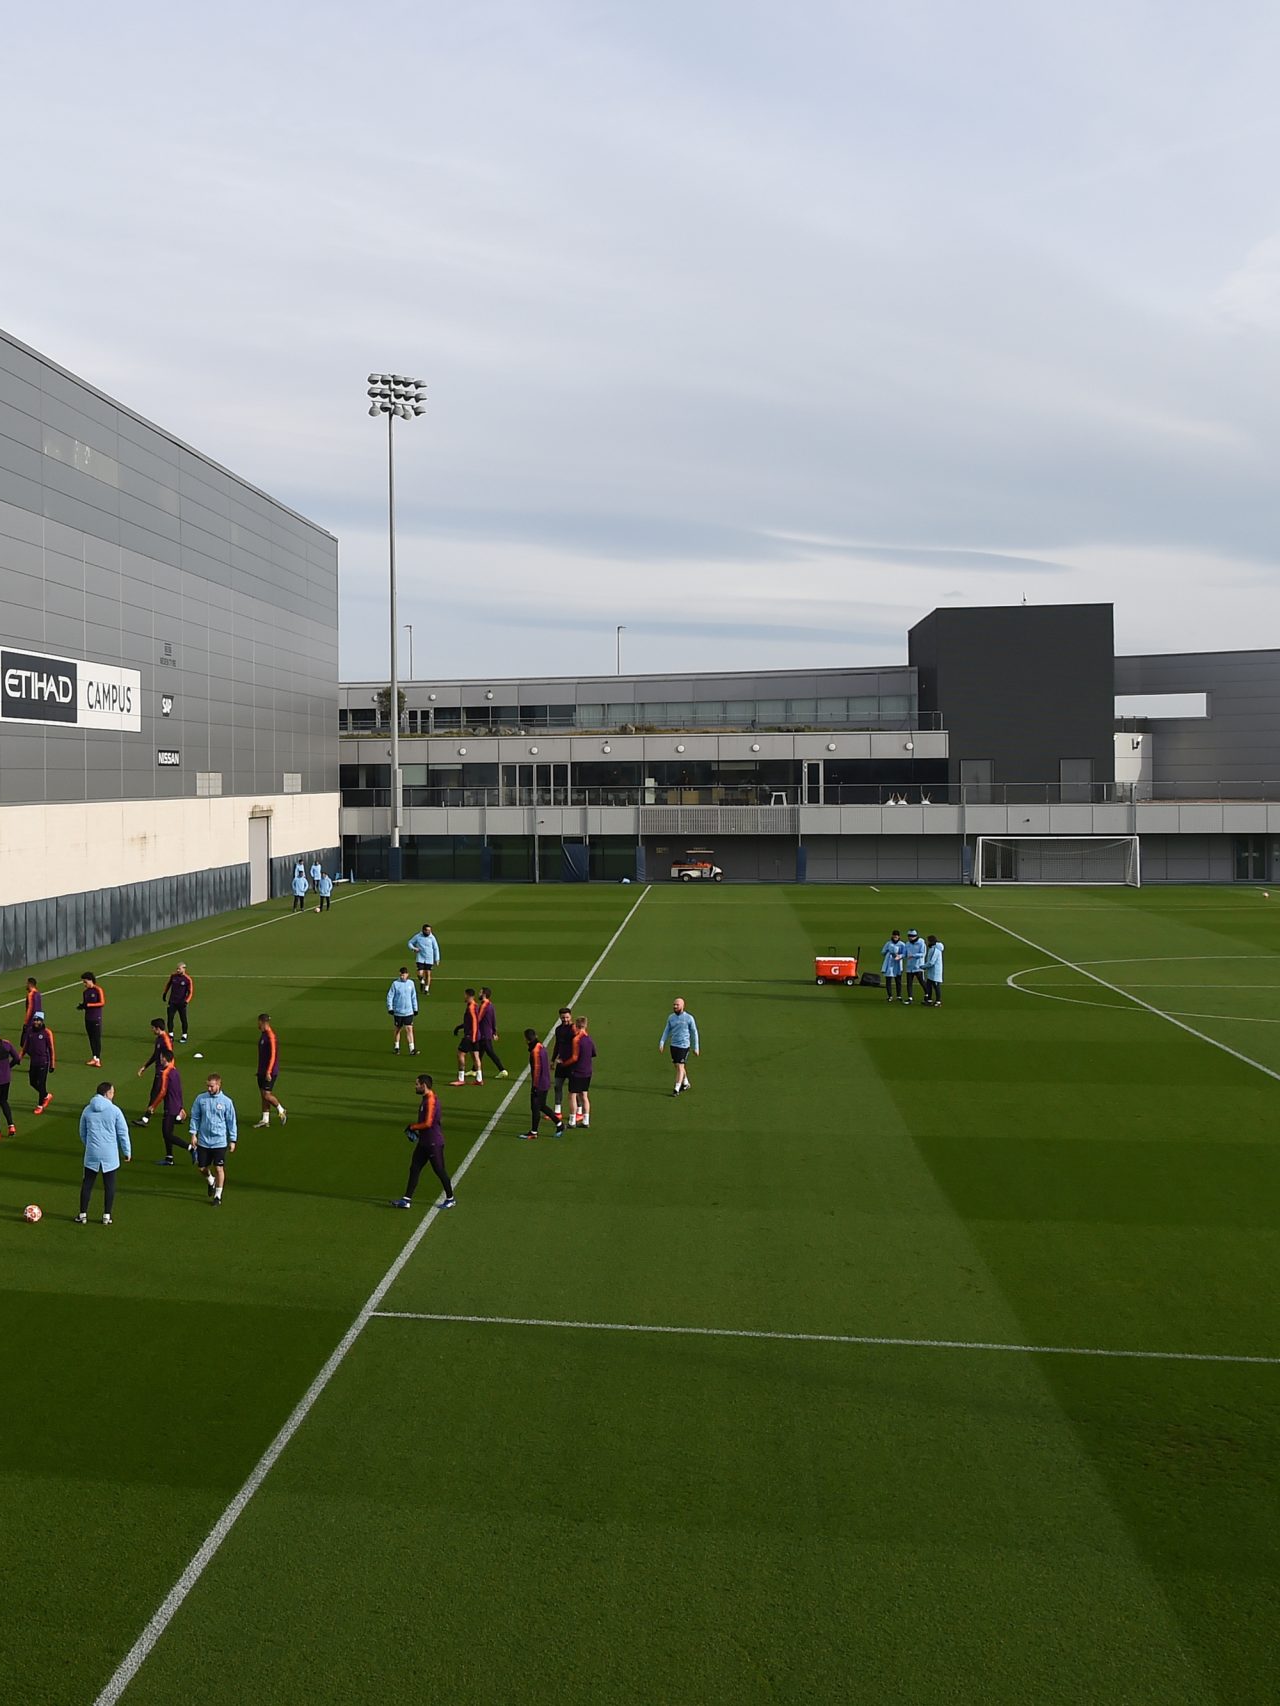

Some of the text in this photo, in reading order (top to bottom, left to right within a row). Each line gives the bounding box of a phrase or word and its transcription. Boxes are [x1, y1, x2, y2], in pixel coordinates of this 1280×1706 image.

[5, 668, 132, 713] ETIHAD CAMPUS
[158, 752, 180, 765] NISSAN
[831, 966, 840, 975] G
